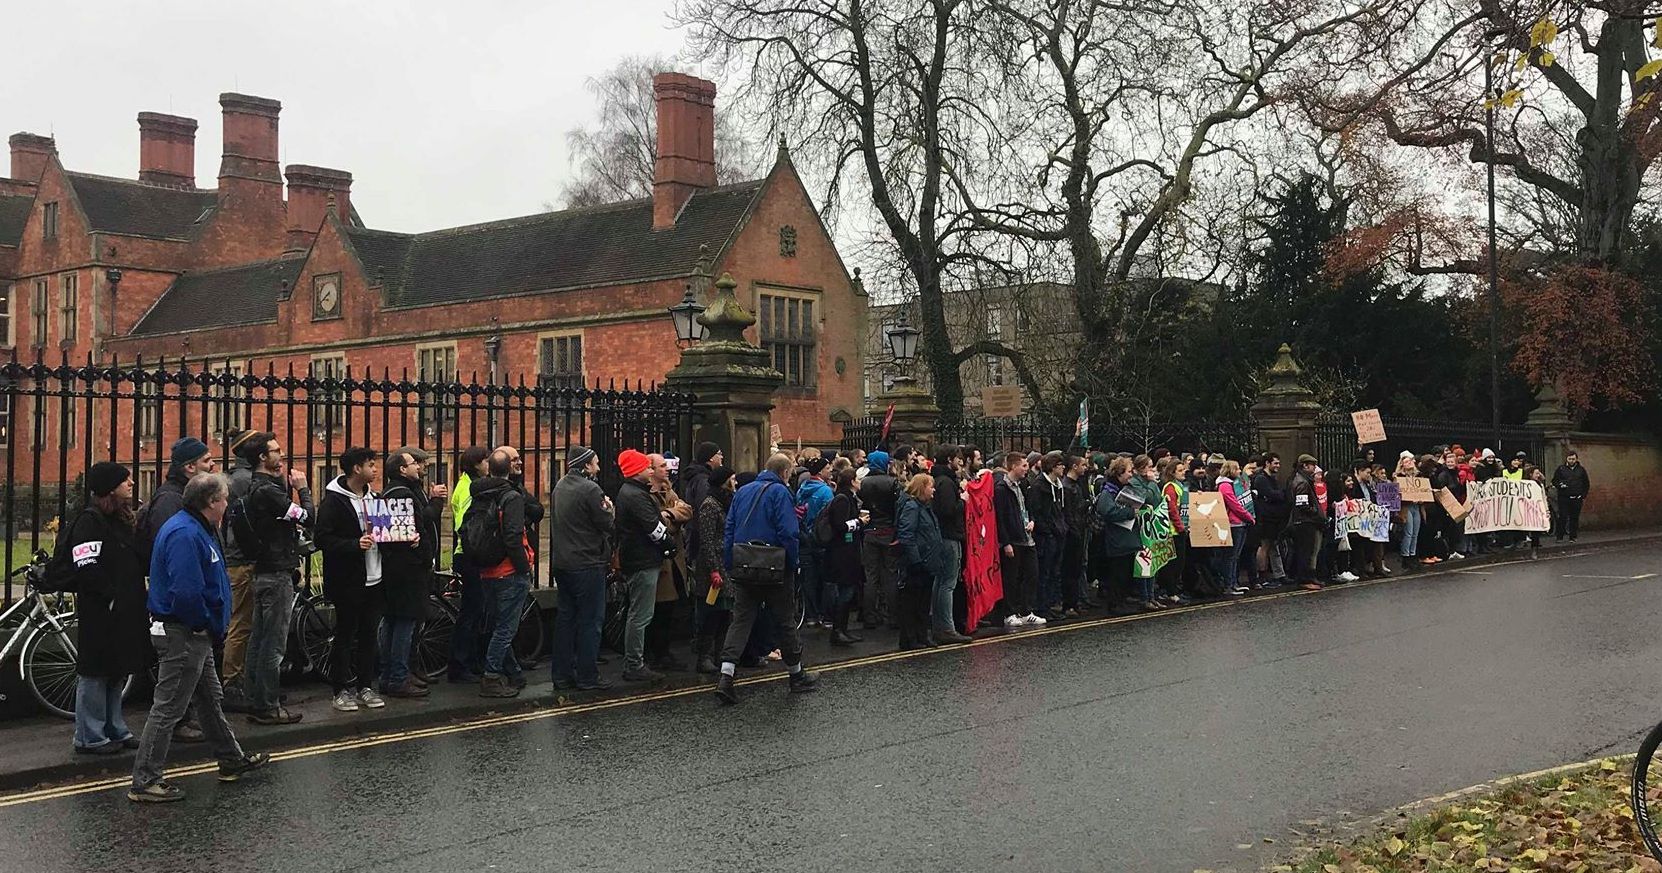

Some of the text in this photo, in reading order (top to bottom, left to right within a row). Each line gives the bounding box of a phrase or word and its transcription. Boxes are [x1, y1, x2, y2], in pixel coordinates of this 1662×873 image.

[1489, 481, 1532, 499] STUDENTS
[361, 497, 415, 517] WAGES
[1492, 495, 1514, 527] UCU
[73, 543, 98, 557] UCU
